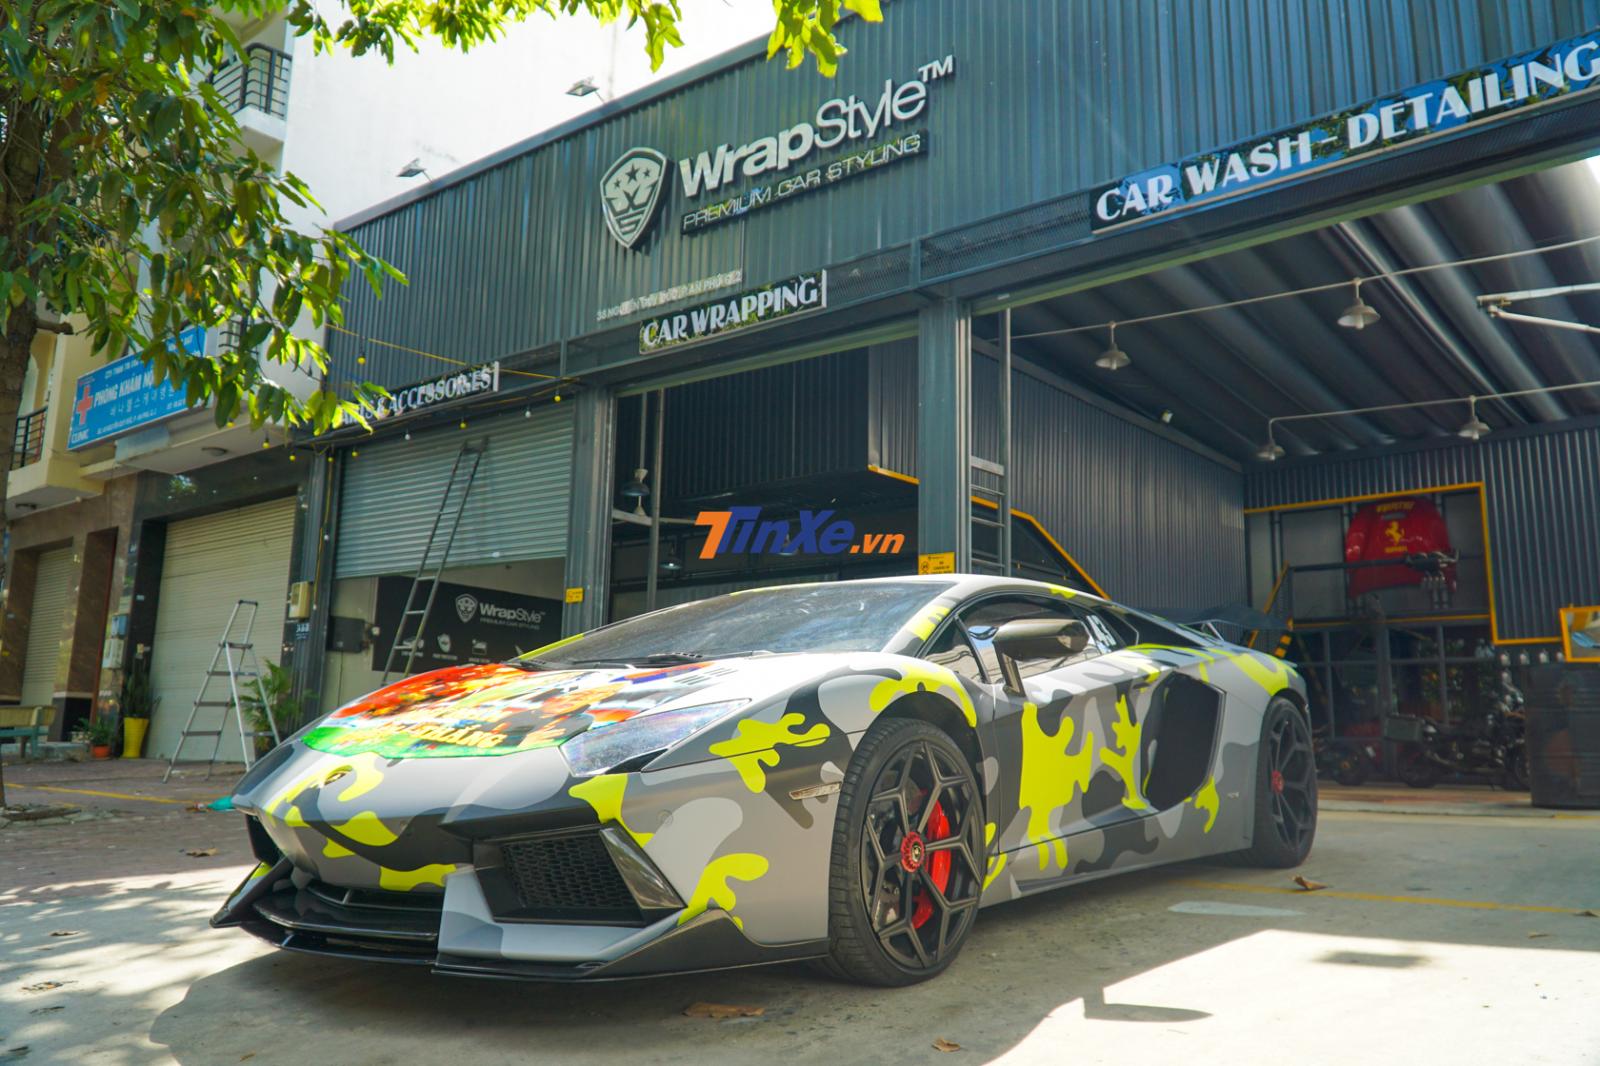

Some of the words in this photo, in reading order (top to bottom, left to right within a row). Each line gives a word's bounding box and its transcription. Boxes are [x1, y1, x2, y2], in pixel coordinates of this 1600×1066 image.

[1096, 173, 1174, 221] CAR
[1186, 132, 1313, 196] WASH
[1347, 41, 1600, 150] DETAILING
[682, 186, 772, 230] PREMIUM
[777, 169, 822, 198] CAR
[828, 134, 921, 180] STYLING
[642, 315, 688, 346] CAR
[690, 277, 820, 333] WRAPPING
[388, 367, 491, 414] ACCESSORIES
